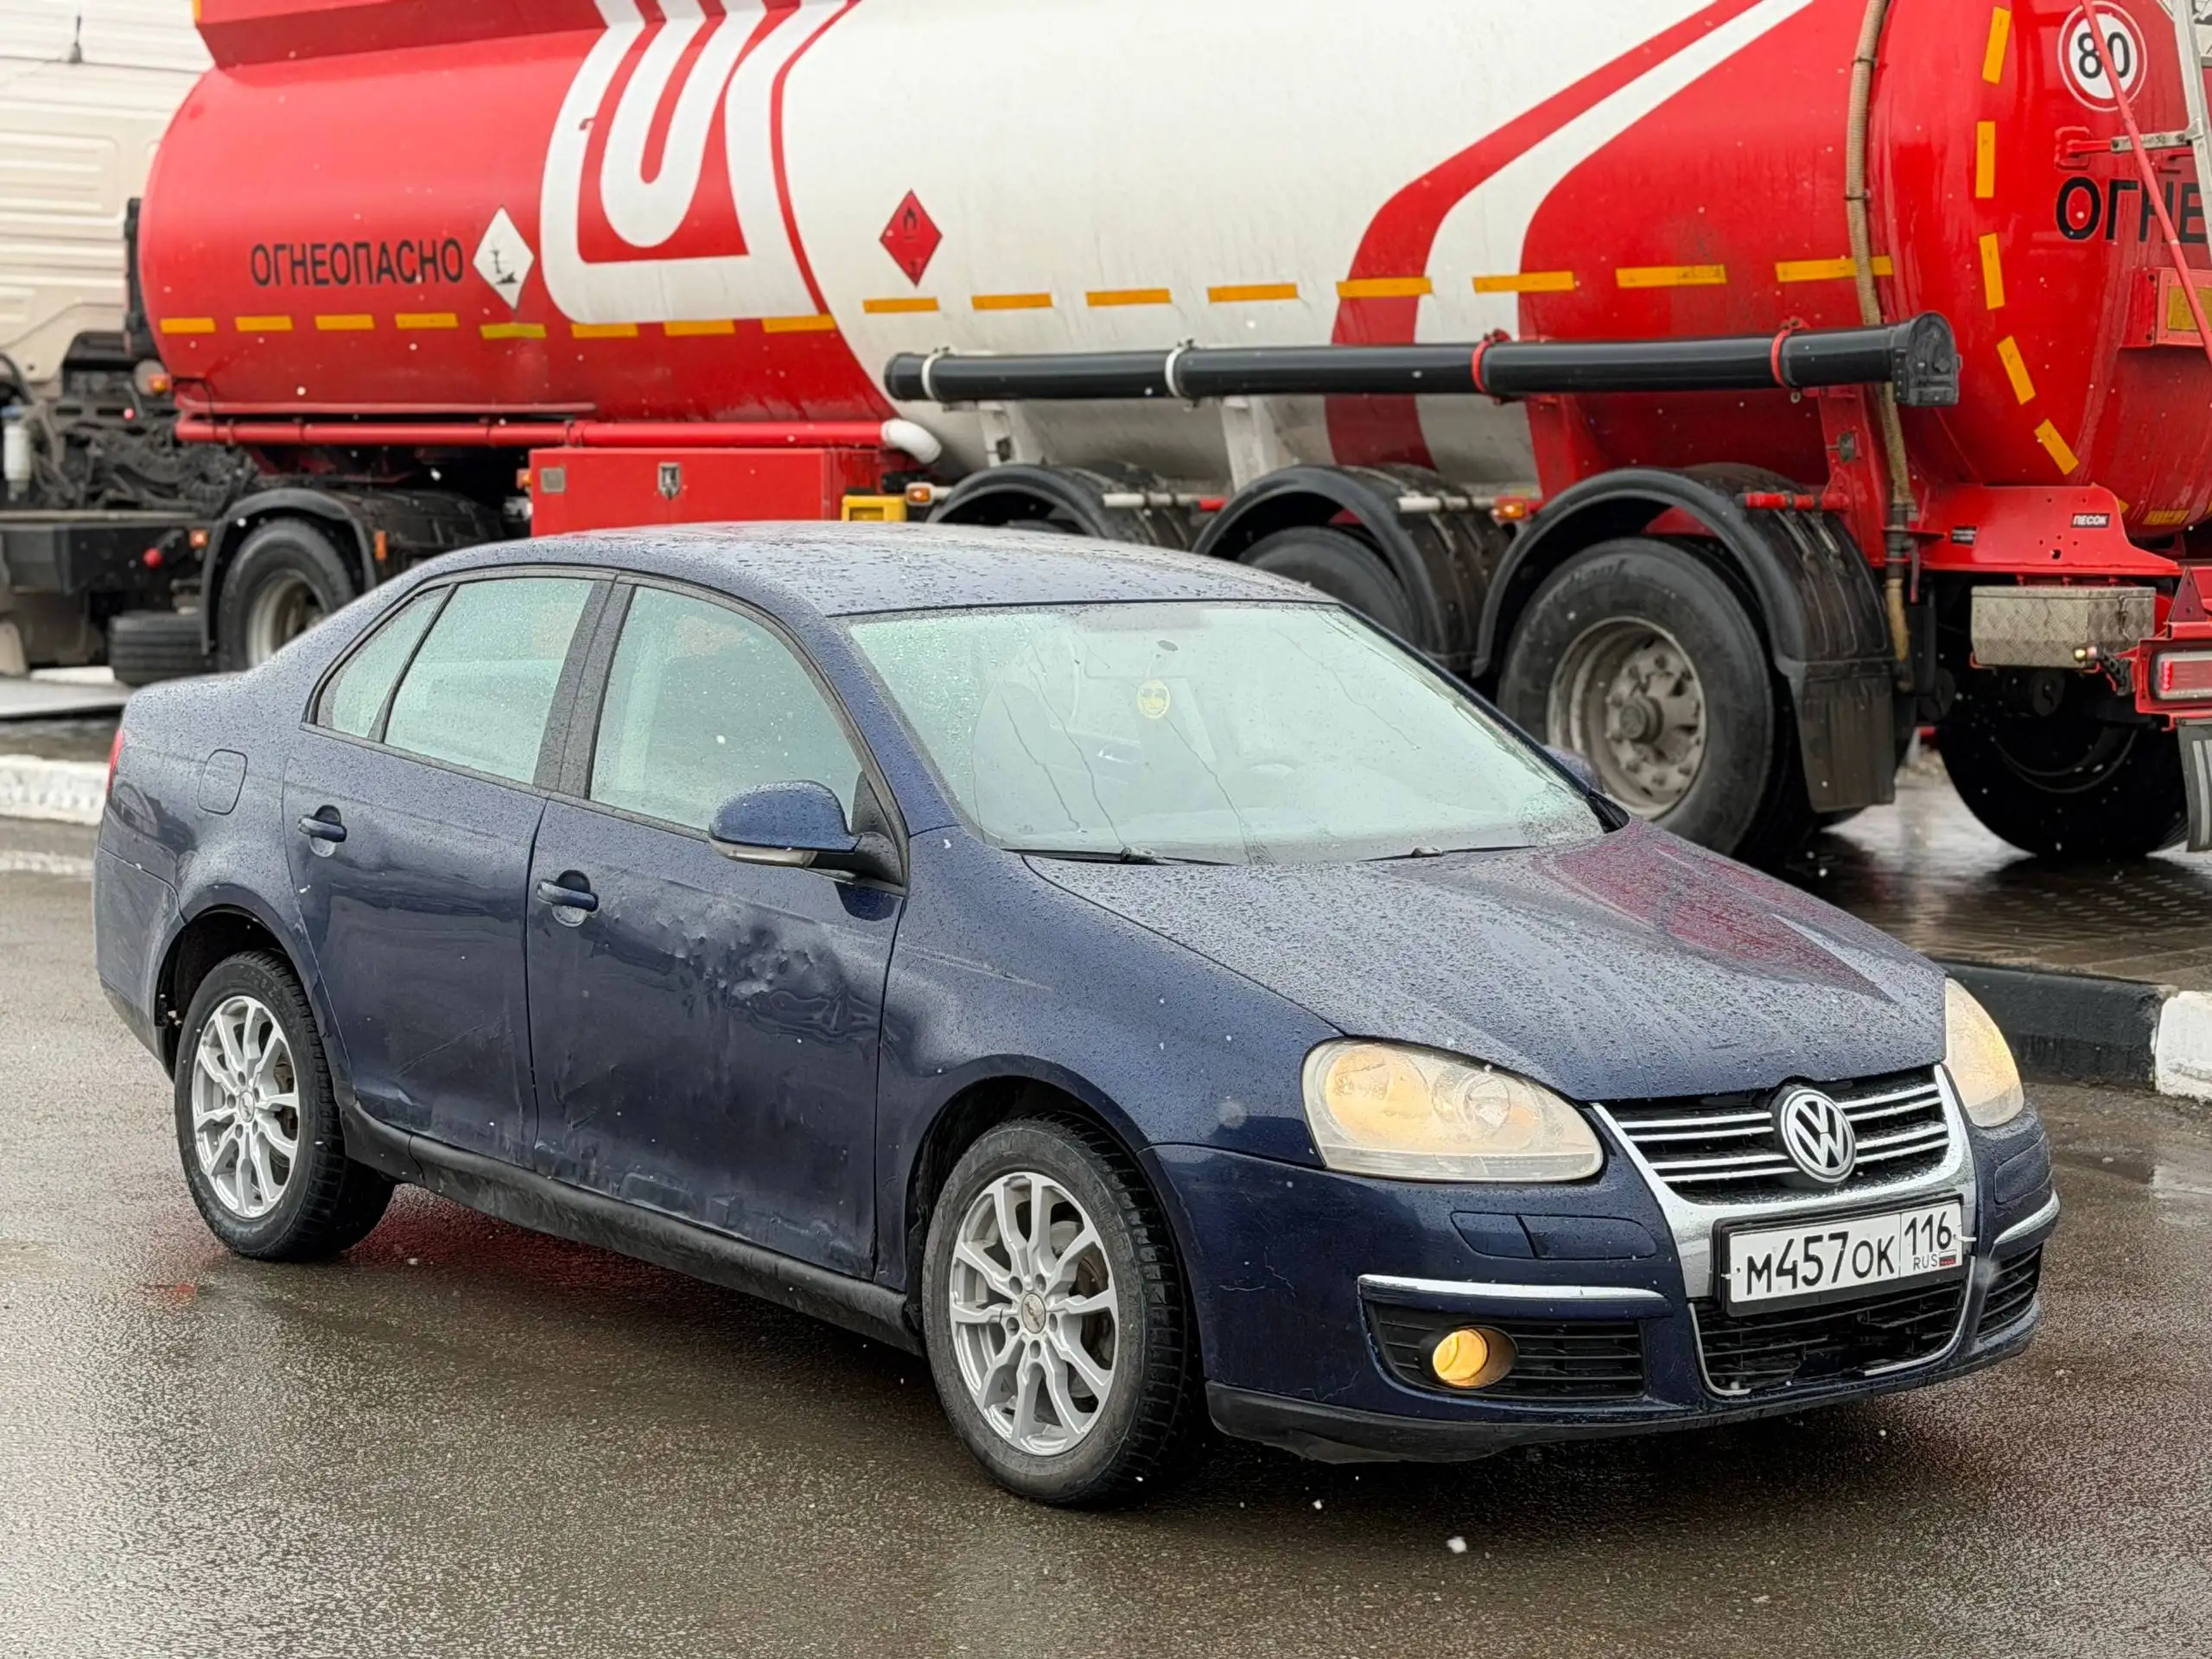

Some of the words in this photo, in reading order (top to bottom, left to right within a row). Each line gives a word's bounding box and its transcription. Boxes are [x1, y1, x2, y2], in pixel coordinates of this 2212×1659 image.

[2077, 31, 2131, 79] 80
[251, 238, 464, 286] ОГНЕОПАСНО
[2073, 515, 2107, 525] ПЕСОК
[1912, 1253, 1938, 1271] RUS
